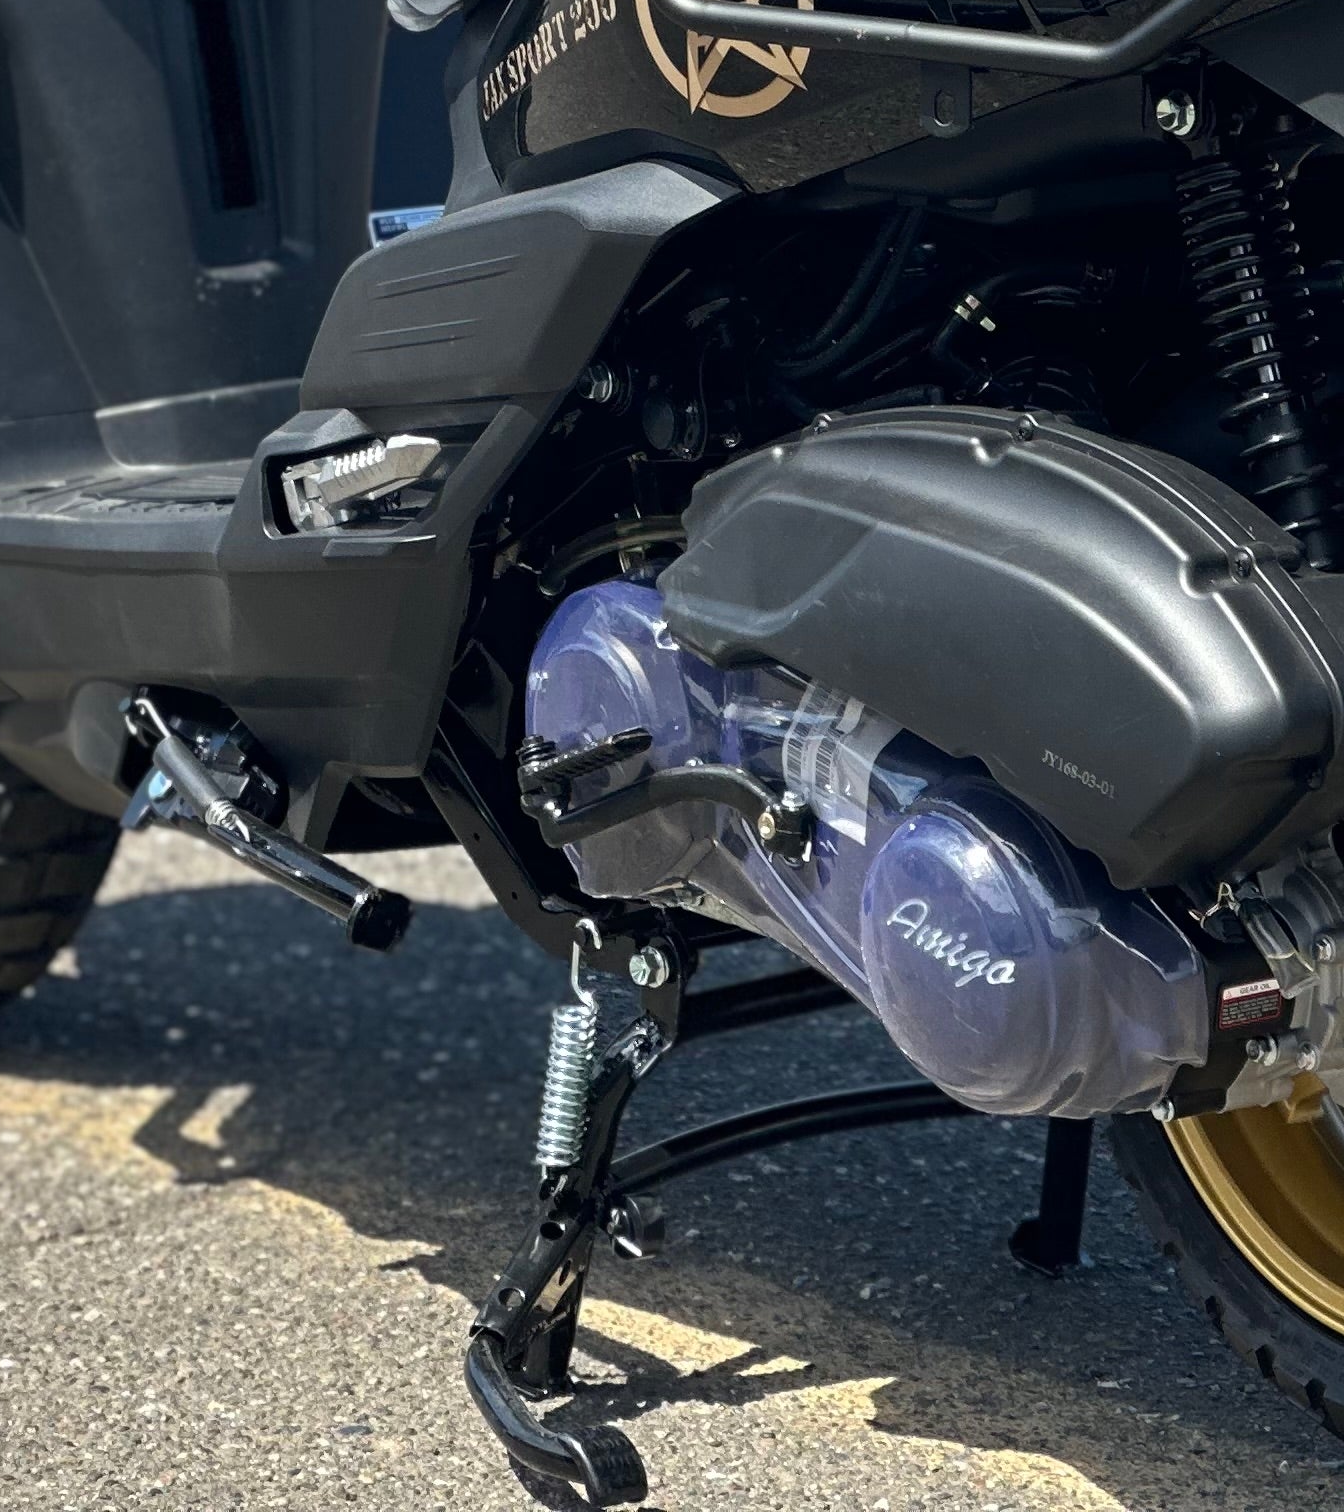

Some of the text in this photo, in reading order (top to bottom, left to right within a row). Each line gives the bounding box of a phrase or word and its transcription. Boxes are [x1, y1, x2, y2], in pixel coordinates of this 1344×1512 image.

[506, 10, 568, 94] SPORT
[886, 898, 1016, 988] Amigo
[1240, 984, 1259, 994] GEAR
